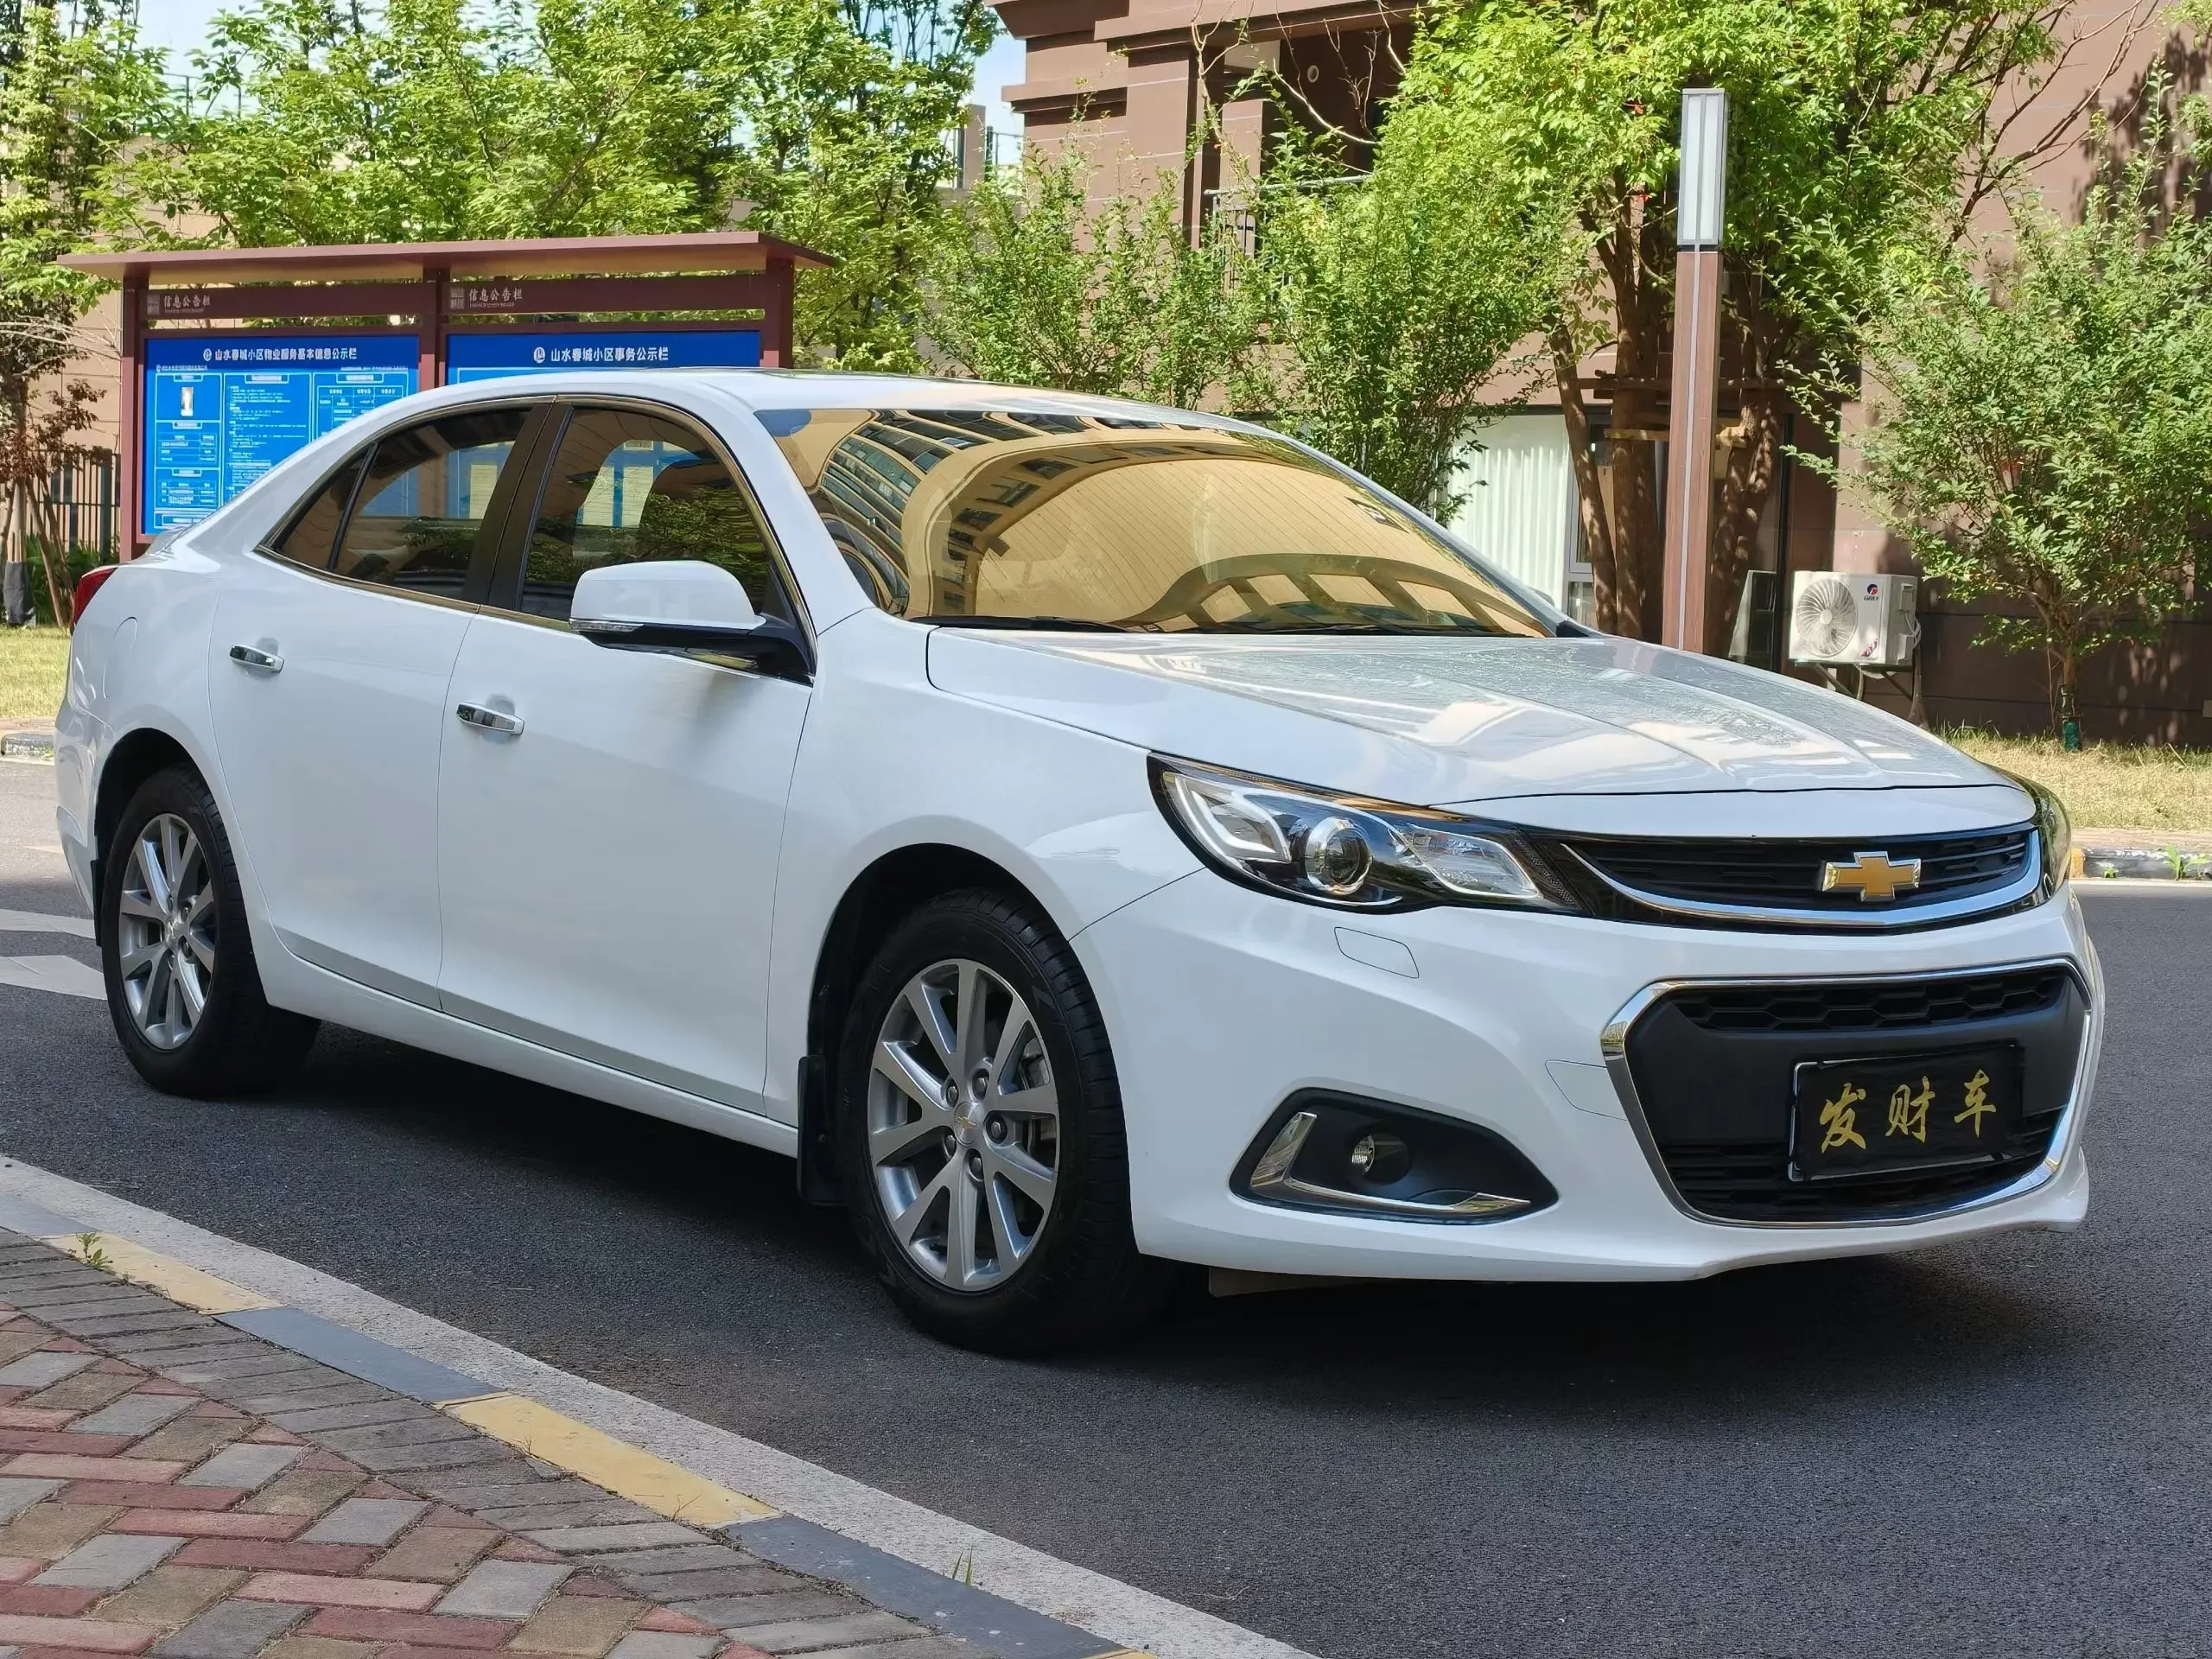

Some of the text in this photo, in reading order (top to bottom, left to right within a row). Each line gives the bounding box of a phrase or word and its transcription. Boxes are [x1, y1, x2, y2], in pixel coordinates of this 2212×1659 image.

[469, 287, 523, 302] 信息公告栏
[214, 347, 357, 361] 山水春城小区物业服务基本信息公示栏
[550, 346, 669, 362] 山水春城小区事务公示栏
[1819, 1069, 1997, 1154] 发财车
